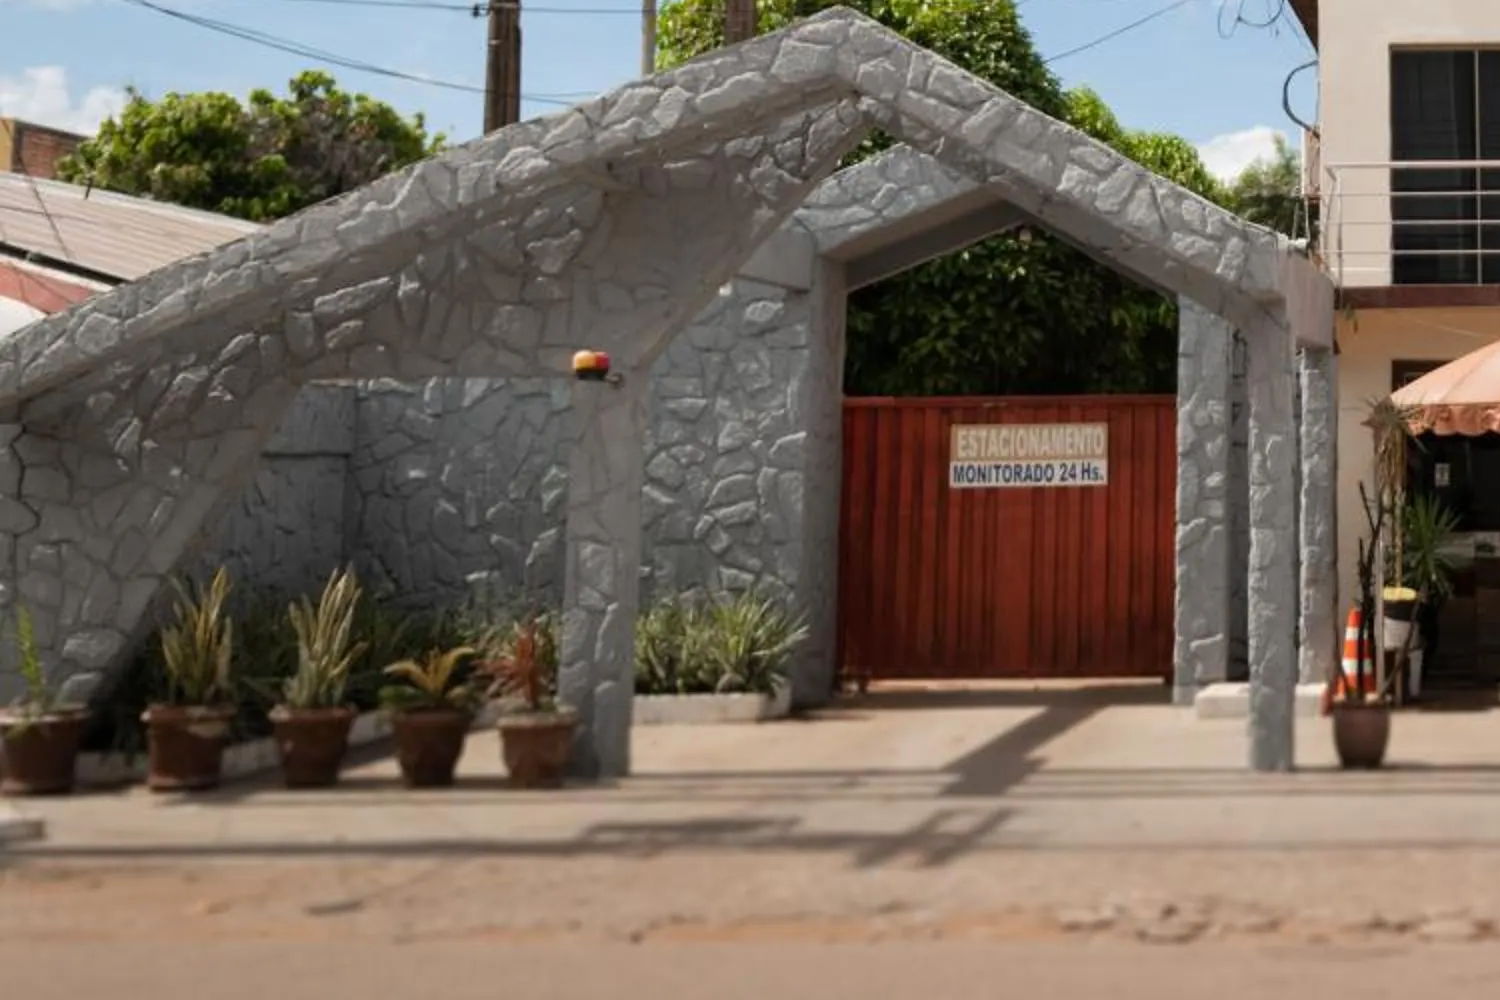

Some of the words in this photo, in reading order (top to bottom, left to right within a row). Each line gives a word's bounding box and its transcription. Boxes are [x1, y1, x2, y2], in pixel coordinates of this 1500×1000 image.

[957, 426, 1106, 459] ESTACIONAMENTO
[953, 464, 1055, 484] MONITORADO
[1059, 462, 1077, 482] 24
[1081, 461, 1105, 482] Hs.
